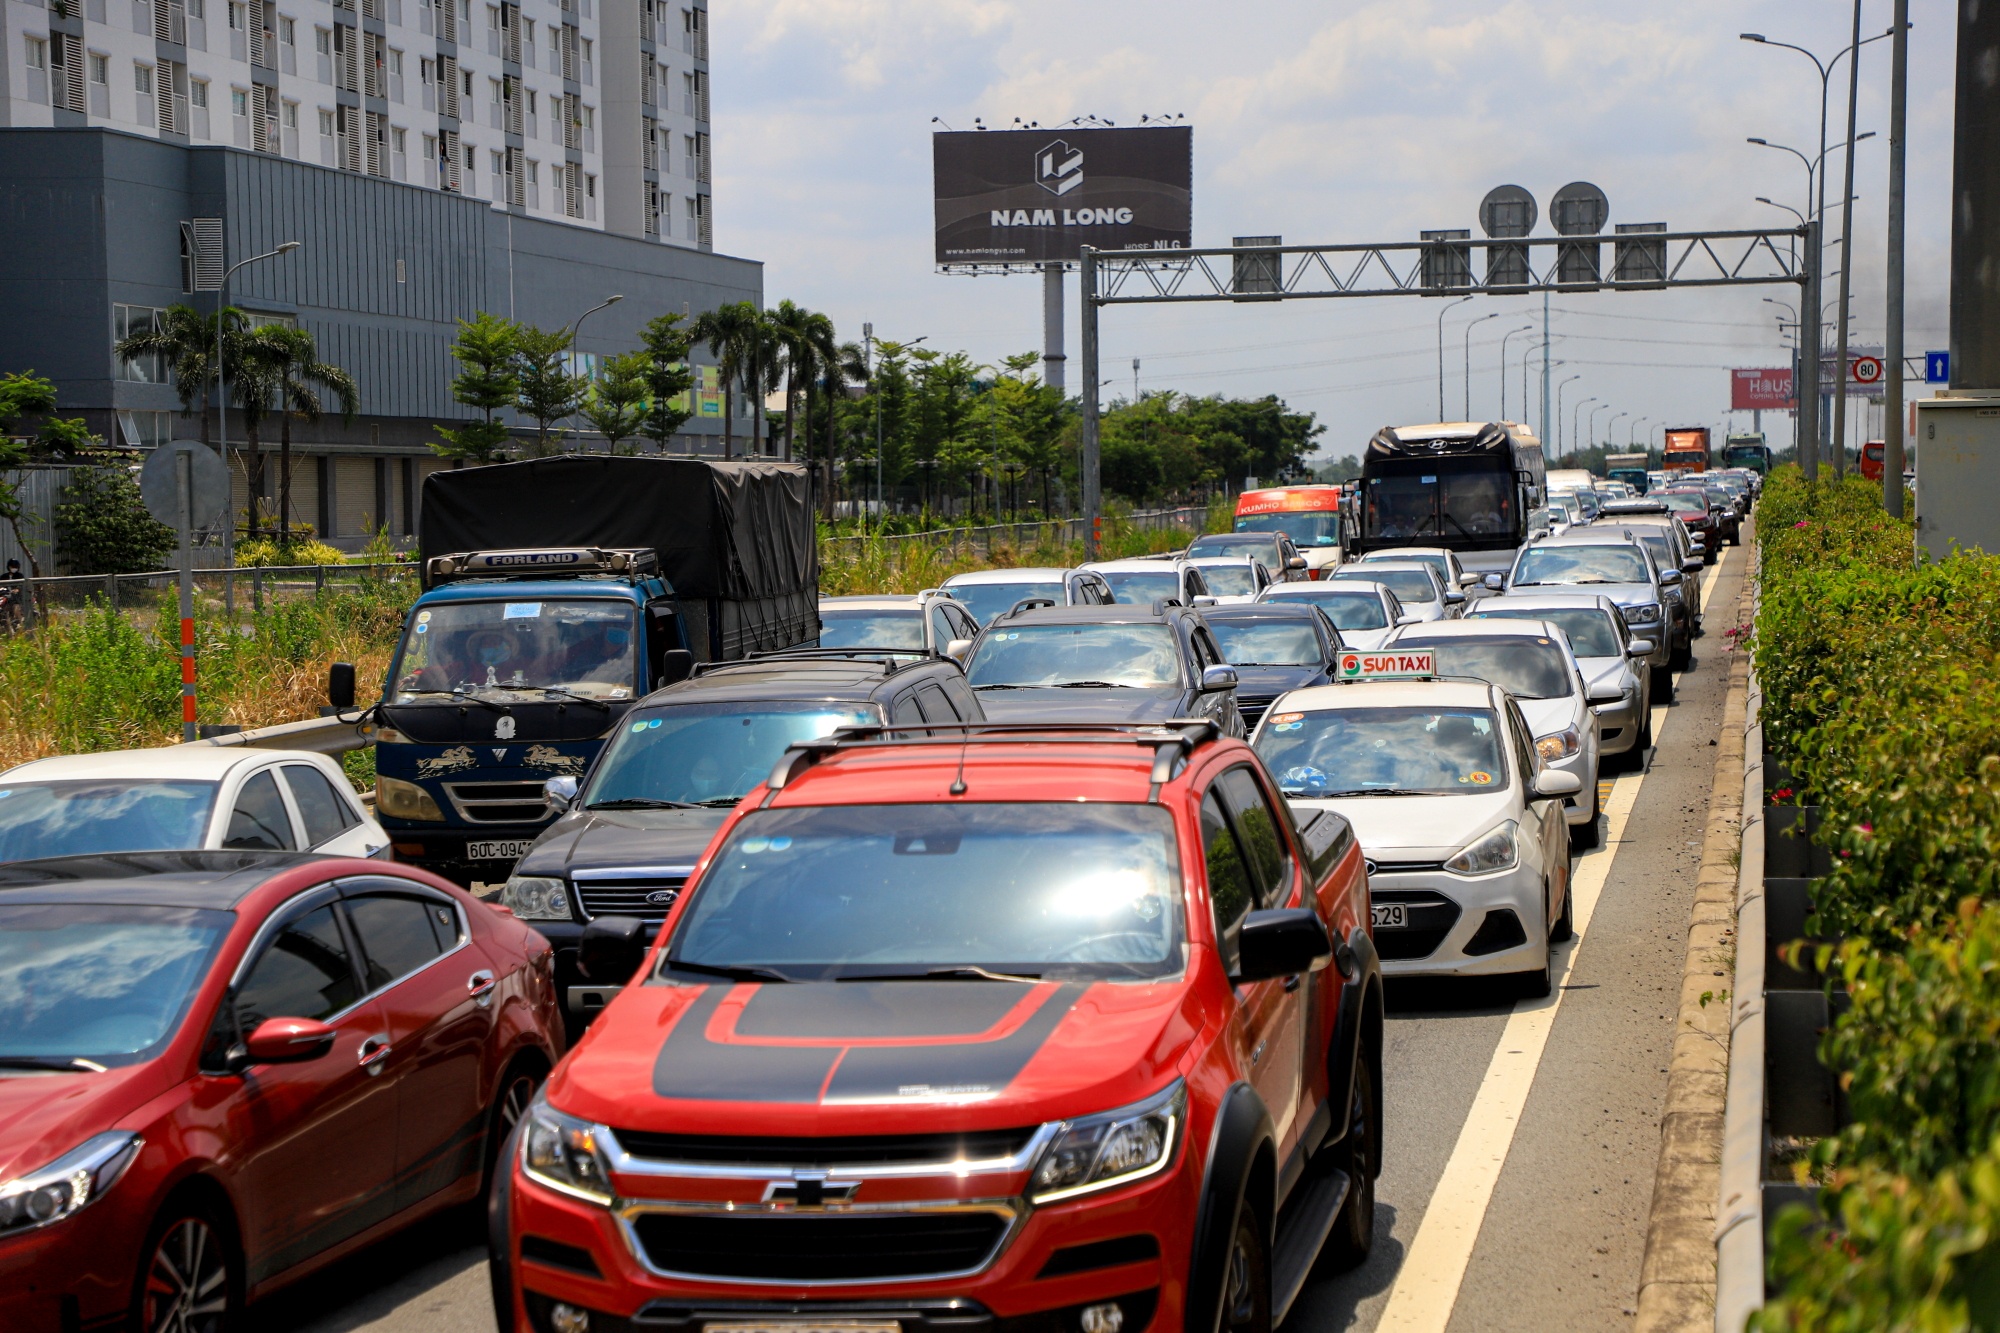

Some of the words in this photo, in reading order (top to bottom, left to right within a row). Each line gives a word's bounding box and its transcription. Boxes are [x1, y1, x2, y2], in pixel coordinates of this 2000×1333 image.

[991, 209, 1057, 226] NAM
[1063, 207, 1134, 226] LONG
[1860, 364, 1874, 376] 80
[1241, 502, 1280, 514] KUMHO
[1282, 500, 1322, 508] SAMCO
[492, 553, 574, 565] FORLAND
[1363, 657, 1396, 672] SUN
[1398, 656, 1430, 671] TAXI
